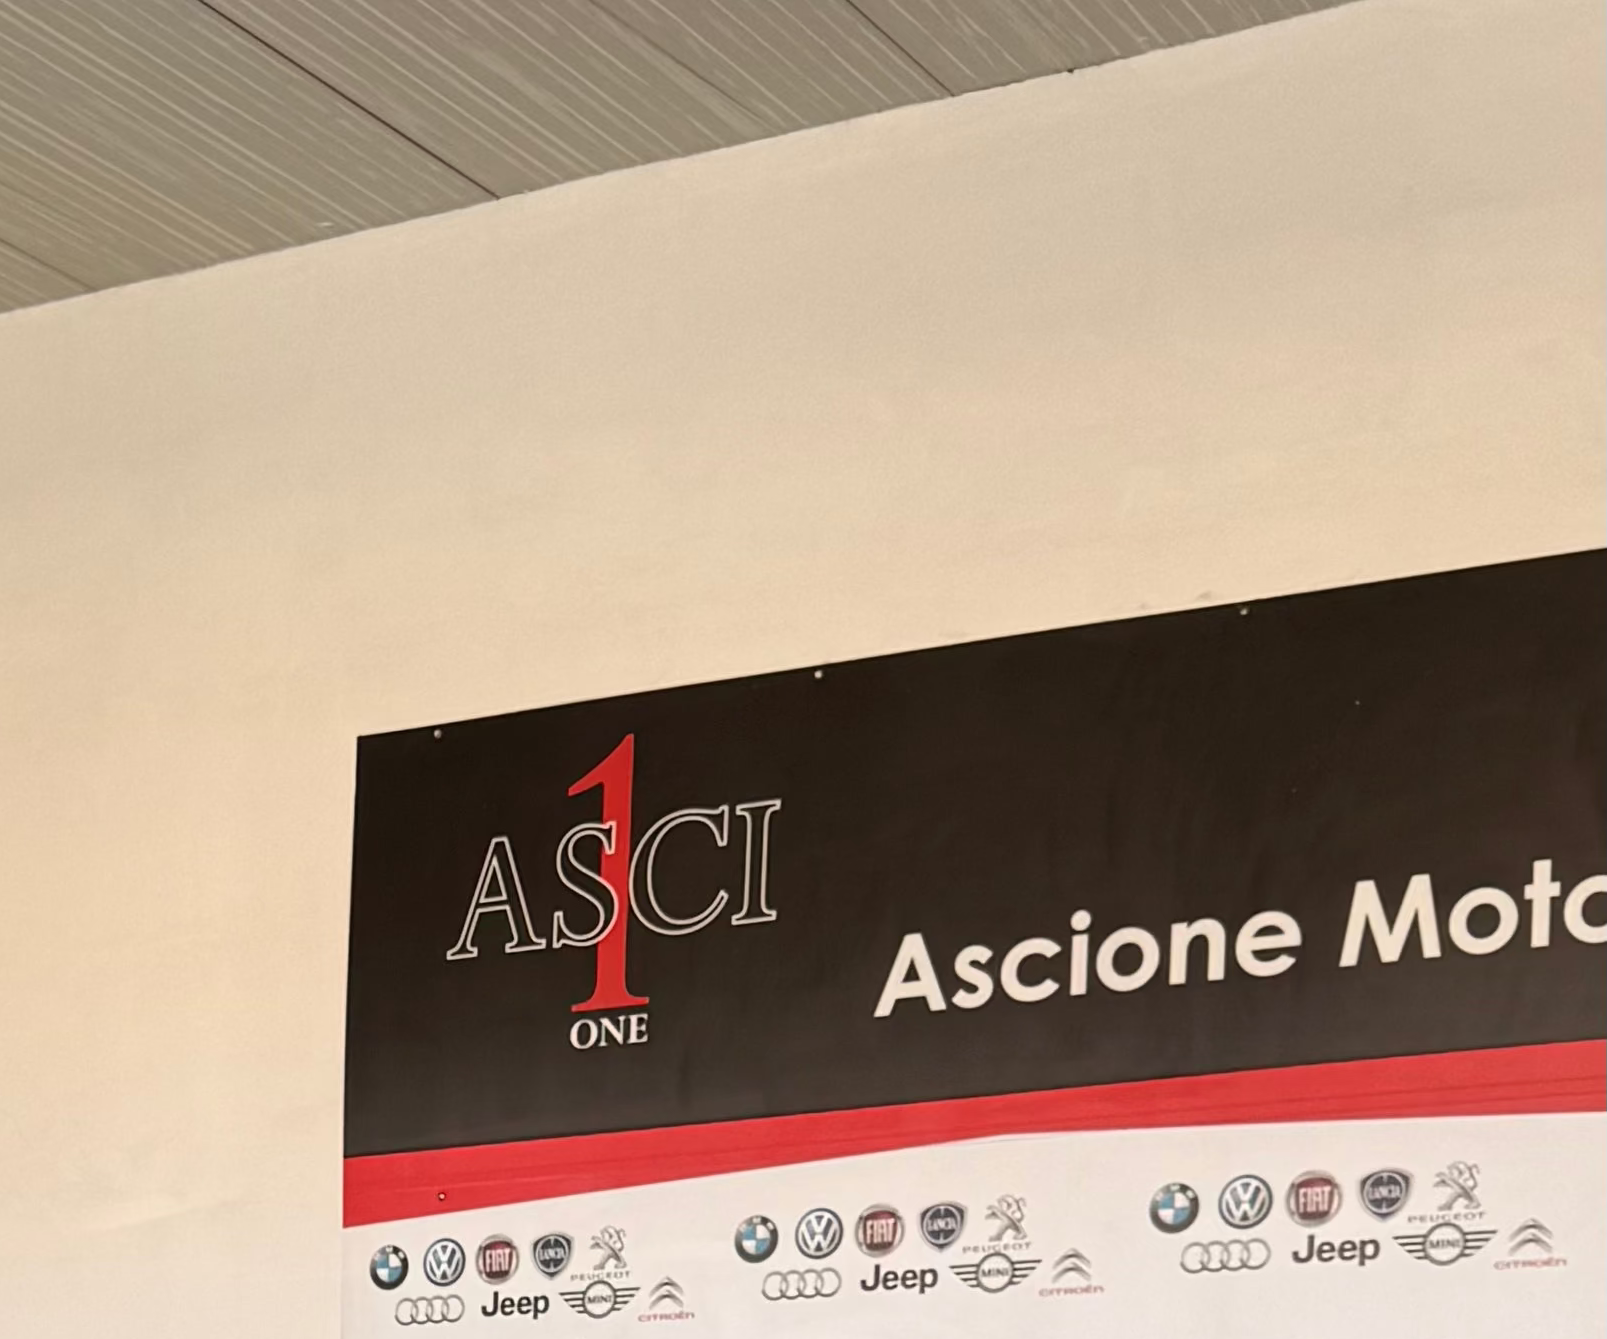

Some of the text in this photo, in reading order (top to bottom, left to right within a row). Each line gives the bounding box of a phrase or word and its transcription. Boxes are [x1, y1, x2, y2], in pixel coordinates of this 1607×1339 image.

[446, 799, 782, 960] ASCI
[872, 858, 1607, 1019] Ascione Moto
[569, 1013, 649, 1050] ONE
[1299, 1185, 1332, 1213] FIAT
[866, 1218, 896, 1244] FIAT
[1428, 1238, 1462, 1250] MINI
[485, 1249, 511, 1273] FIAT
[1291, 1234, 1381, 1267] Jeep
[859, 1264, 939, 1295] Jeep
[980, 1268, 1009, 1279] MINI
[481, 1290, 550, 1320] Jeep
[586, 1294, 614, 1305] MINI
